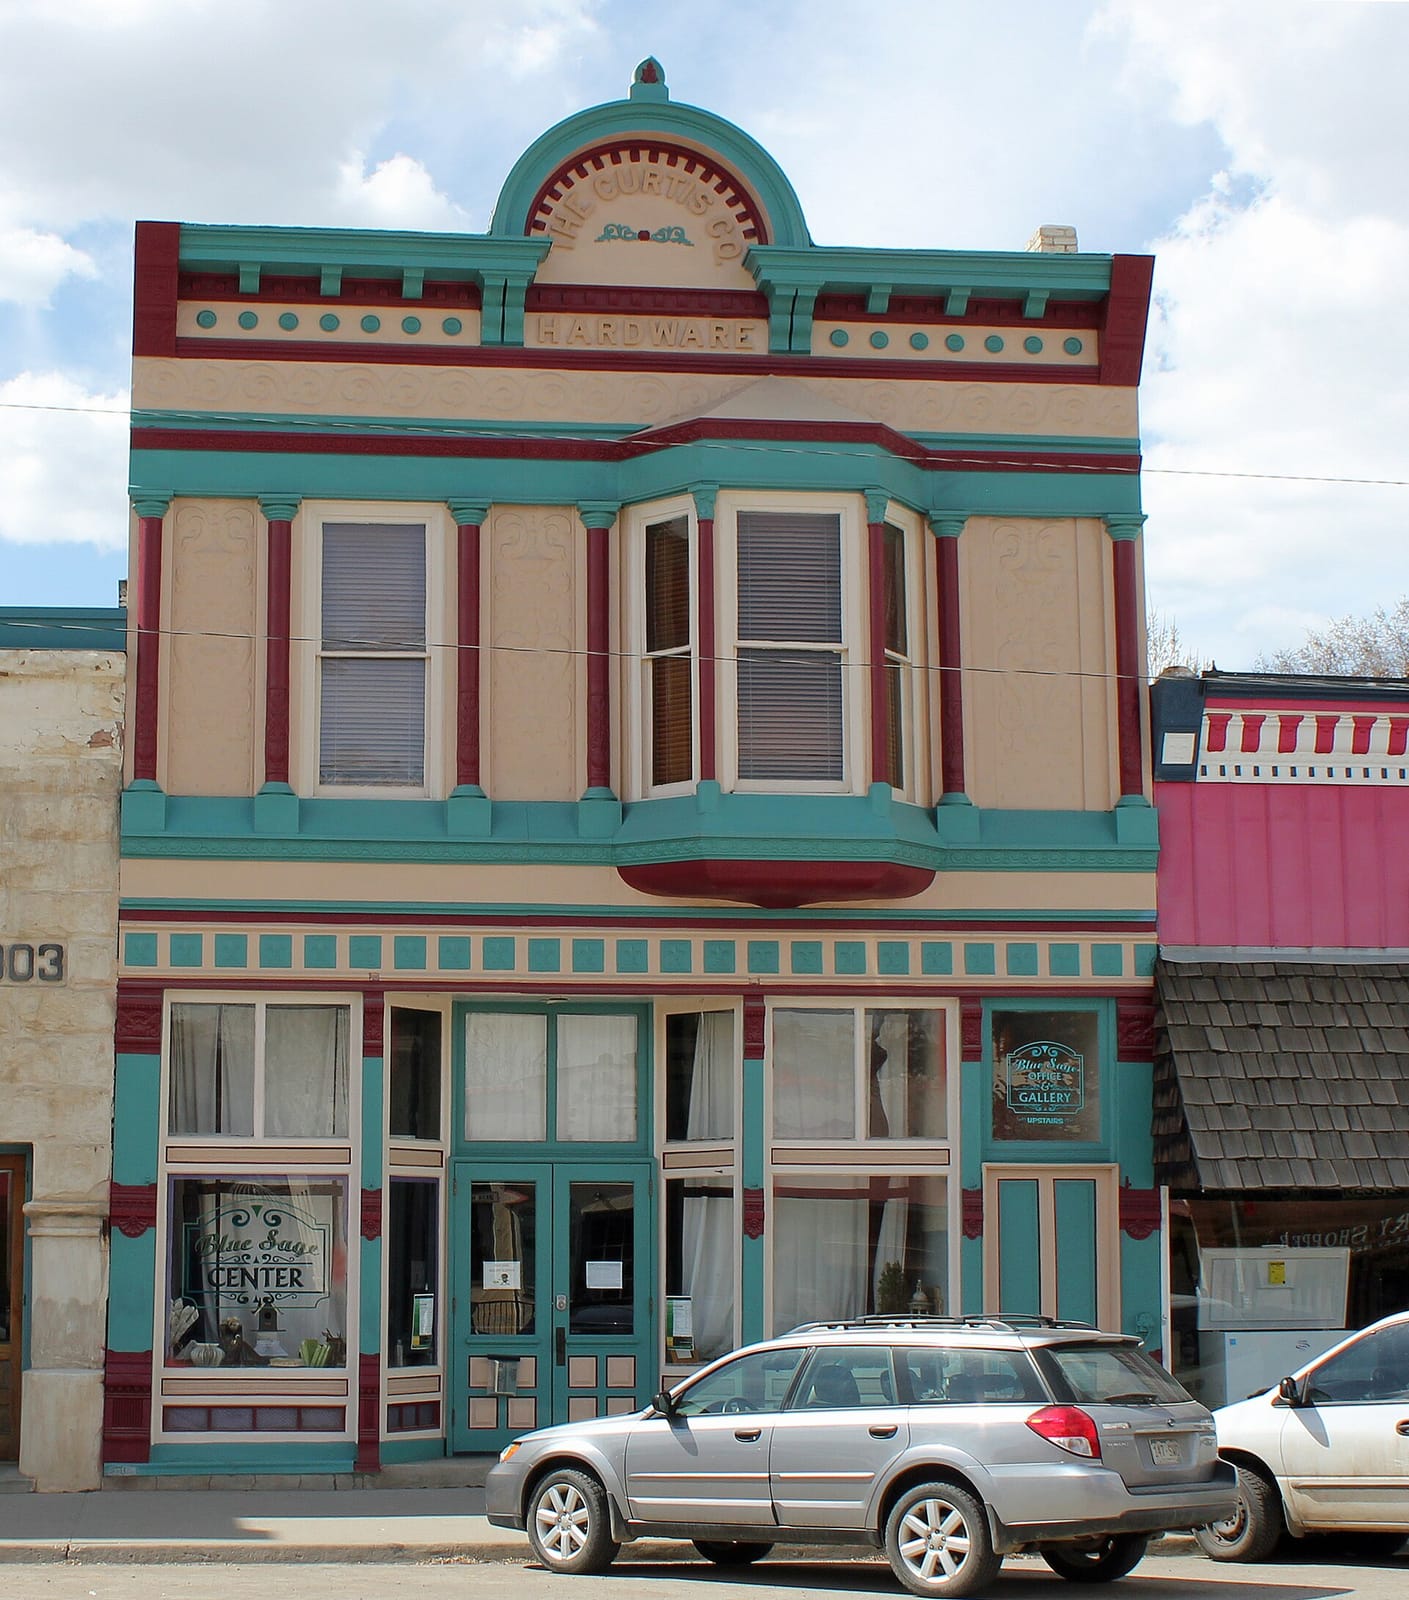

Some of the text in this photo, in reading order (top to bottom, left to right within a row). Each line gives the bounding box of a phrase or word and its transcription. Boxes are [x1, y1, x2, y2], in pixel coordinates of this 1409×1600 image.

[593, 166, 714, 215] CURTIS
[537, 316, 755, 350] HARDWARE
[0, 943, 63, 982] 03
[1013, 1057, 1078, 1073] Blue Sage
[1027, 1072, 1062, 1081] OFFICE
[1040, 1081, 1051, 1091] &
[1019, 1092, 1072, 1103] GALLERY
[1027, 1116, 1064, 1125] UPSTAIRS
[195, 1229, 320, 1257] Blue Sage
[207, 1267, 305, 1290] CENTER
